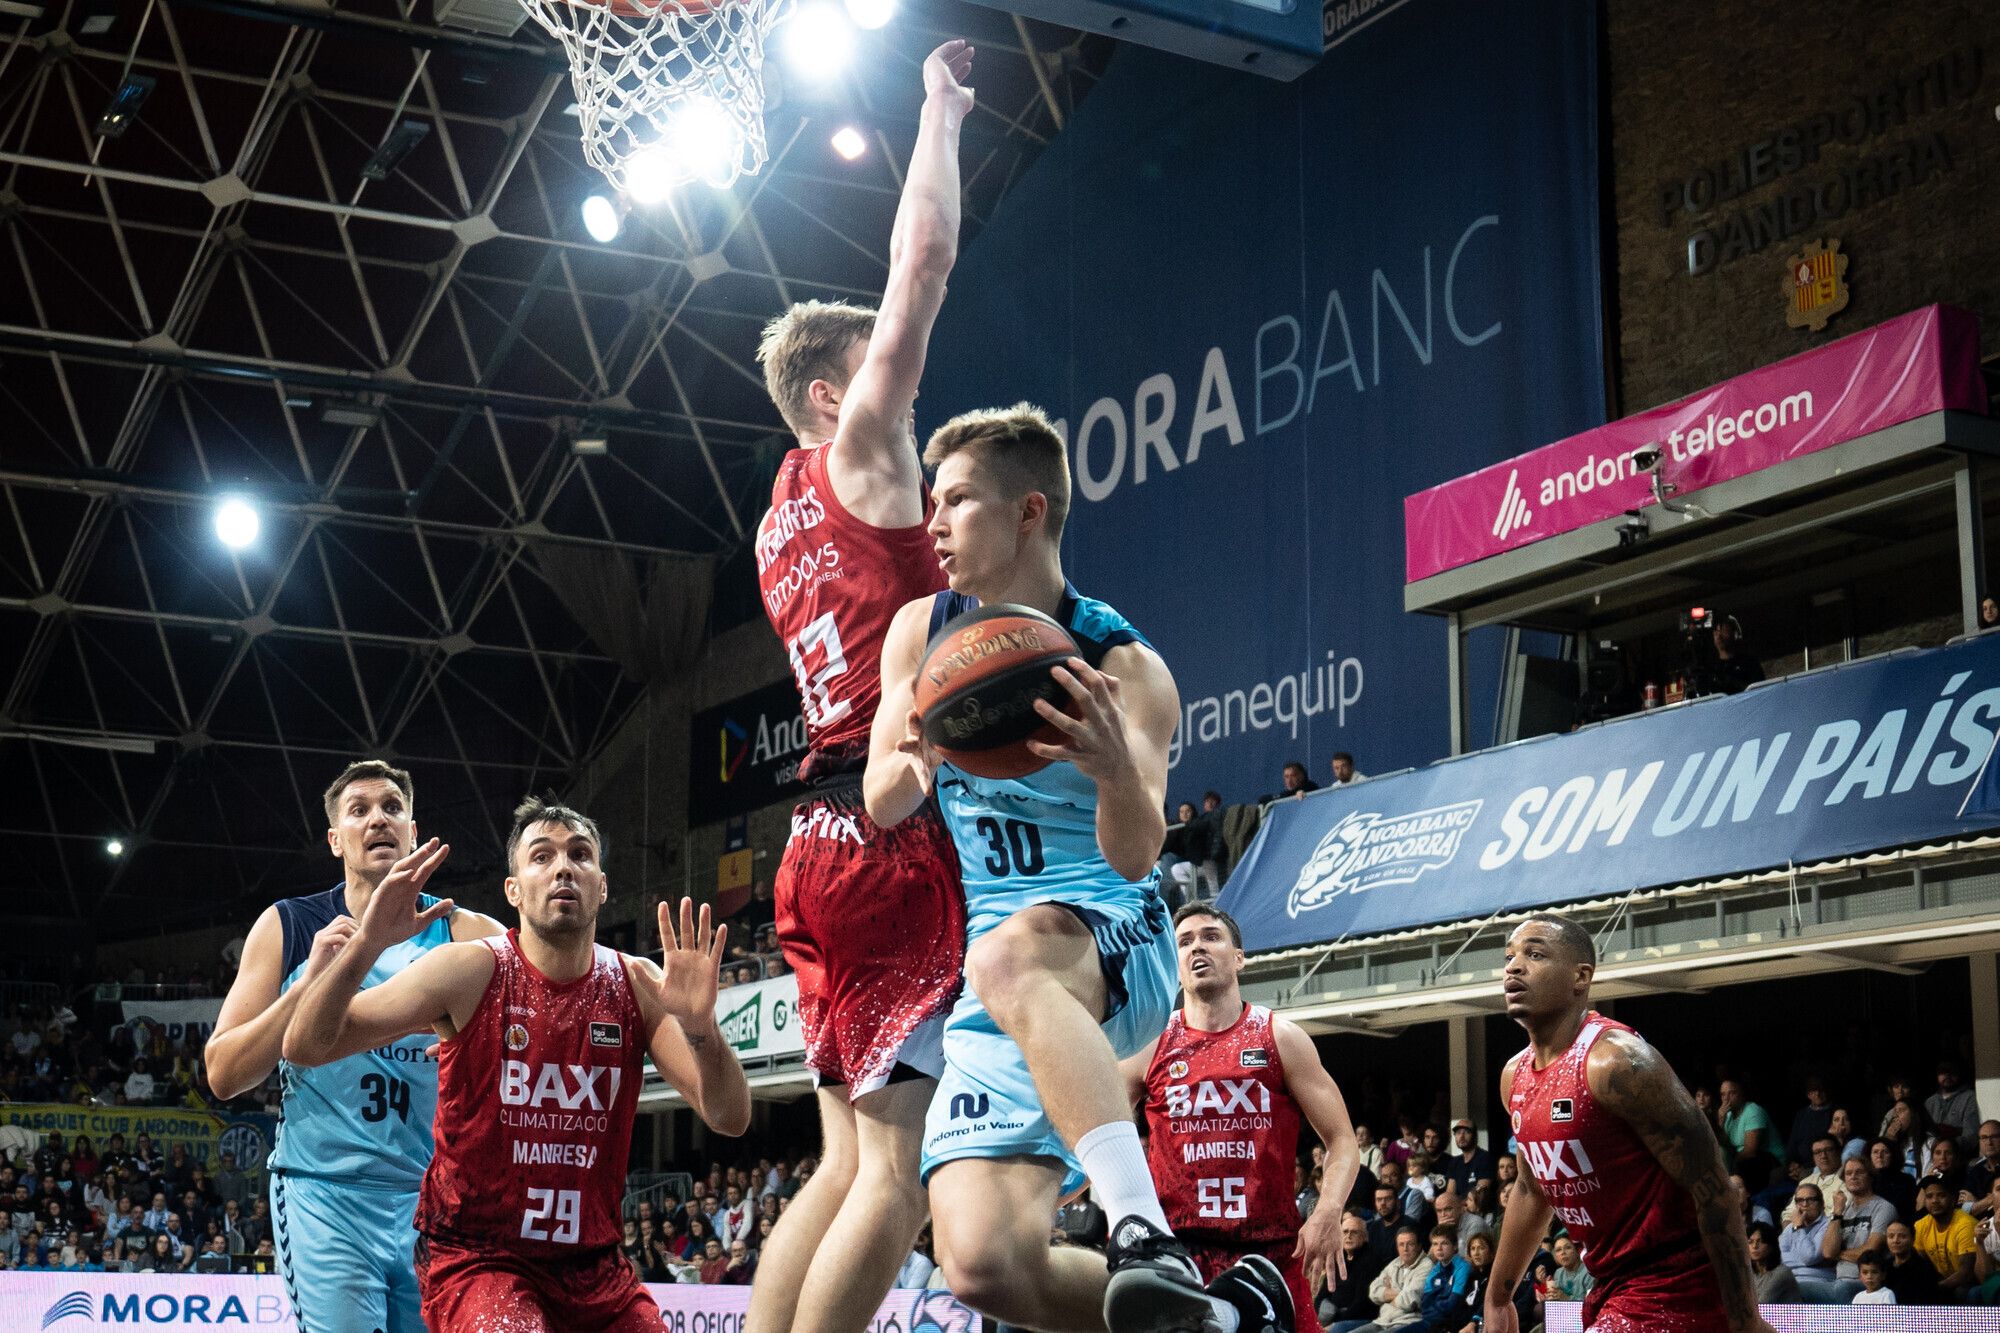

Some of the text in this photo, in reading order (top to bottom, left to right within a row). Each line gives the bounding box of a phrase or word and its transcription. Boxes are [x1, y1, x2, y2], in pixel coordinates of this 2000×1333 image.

[1540, 389, 1814, 506] andor telecom
[788, 610, 848, 733] 12
[1479, 669, 2000, 871] SOM UN PAÍS
[976, 817, 1045, 877] 30
[1363, 808, 1473, 846] MORABANC
[1347, 829, 1458, 873] ANDORRA
[360, 1072, 410, 1125] 34
[499, 1058, 622, 1111] BAXI
[1164, 1078, 1271, 1118] BAXI
[10, 1112, 210, 1138] BASQUET CLUB ANDORRA
[973, 1123, 986, 1133] la
[1170, 1114, 1273, 1134] CLIMATIZACIÓN
[512, 1139, 598, 1169] MANRESA
[1183, 1140, 1257, 1164] MANRESA
[520, 1187, 581, 1245] 29
[1197, 1177, 1248, 1219] 55
